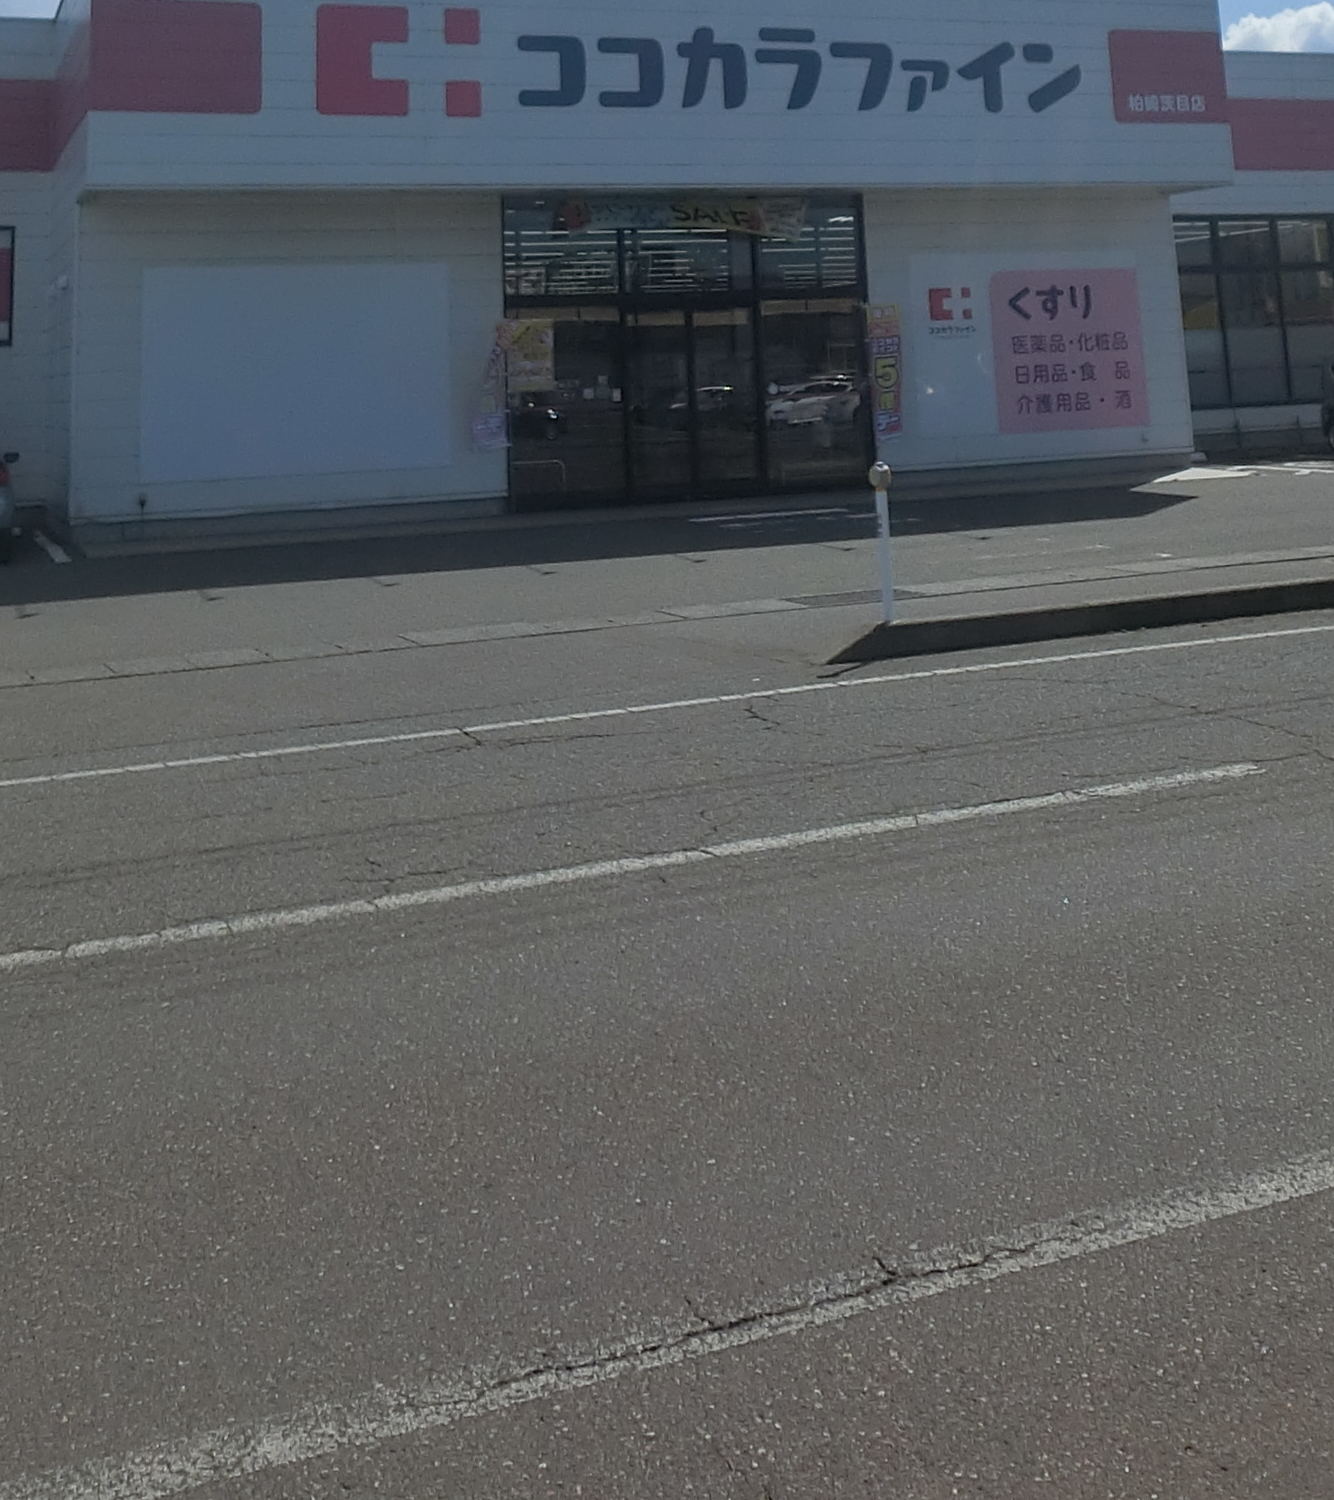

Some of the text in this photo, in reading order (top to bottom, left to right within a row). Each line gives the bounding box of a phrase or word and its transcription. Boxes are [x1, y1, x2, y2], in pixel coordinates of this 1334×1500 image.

[517, 27, 1082, 113] ココカラファイン
[1008, 284, 1093, 321] くすり
